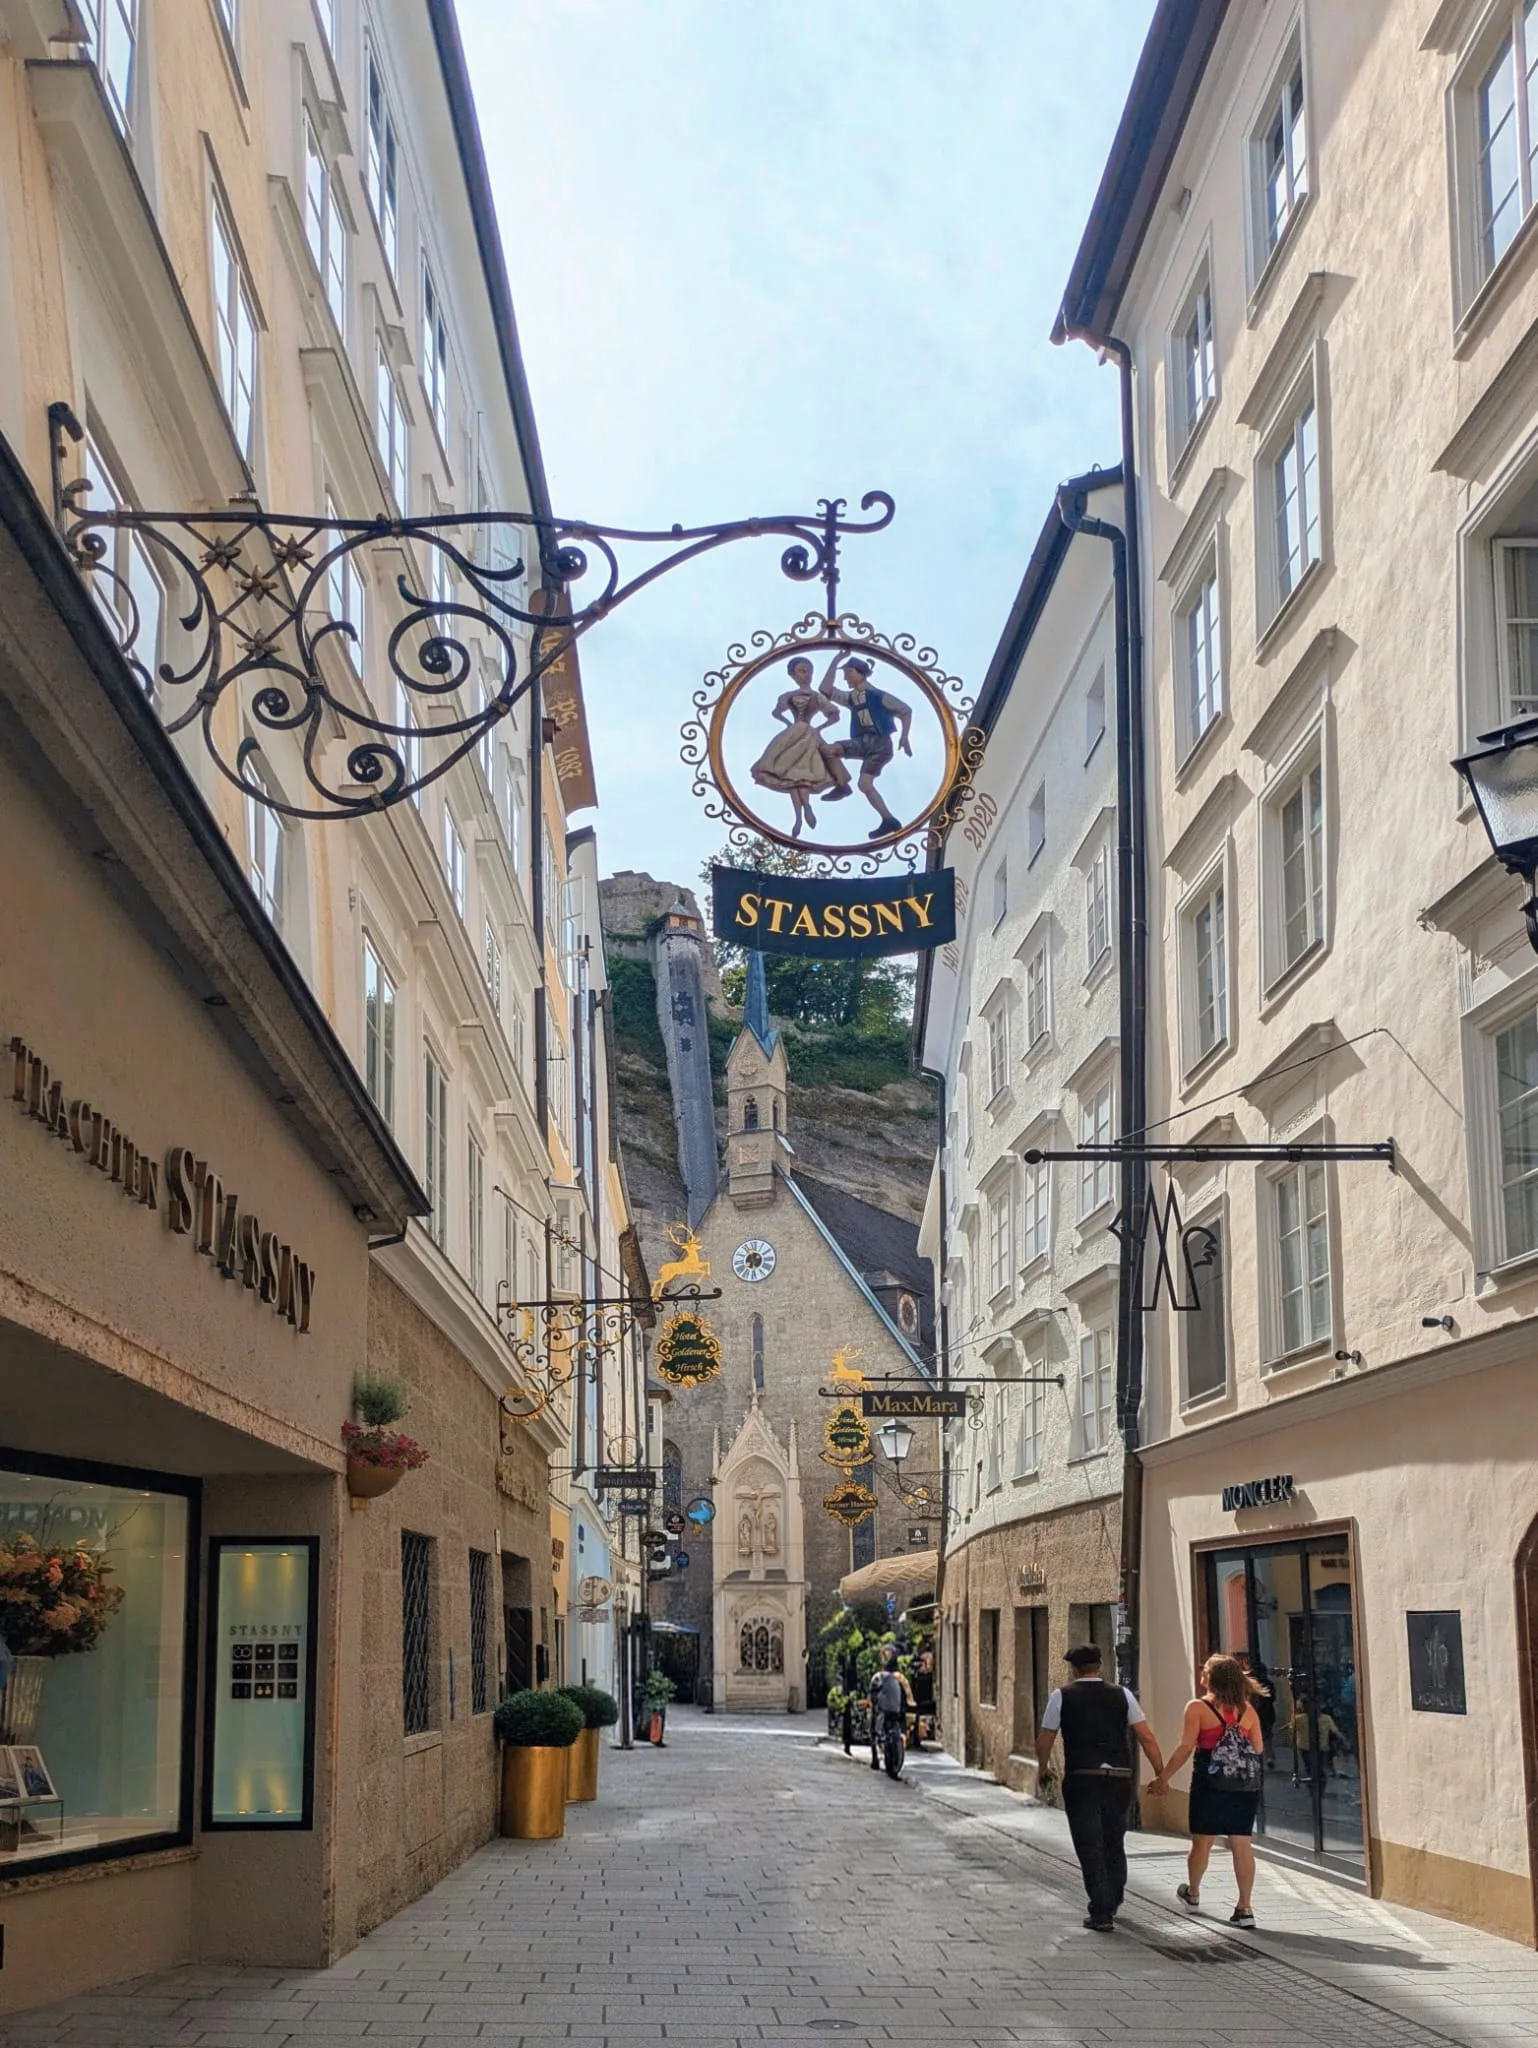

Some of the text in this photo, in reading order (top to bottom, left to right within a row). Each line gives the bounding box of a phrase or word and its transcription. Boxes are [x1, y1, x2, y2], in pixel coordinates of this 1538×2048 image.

[963, 792, 998, 852] 2020
[735, 893, 935, 938] STASSNY
[10, 1037, 316, 1333] TRACHTEN STASSNY
[674, 1332, 699, 1341] Hotel
[671, 1347, 707, 1357] Goldener
[675, 1362, 704, 1372] Hirsch
[871, 1395, 958, 1413] MaxMara
[1222, 1473, 1296, 1512] MONCLER
[229, 1624, 303, 1637] STASSNY
